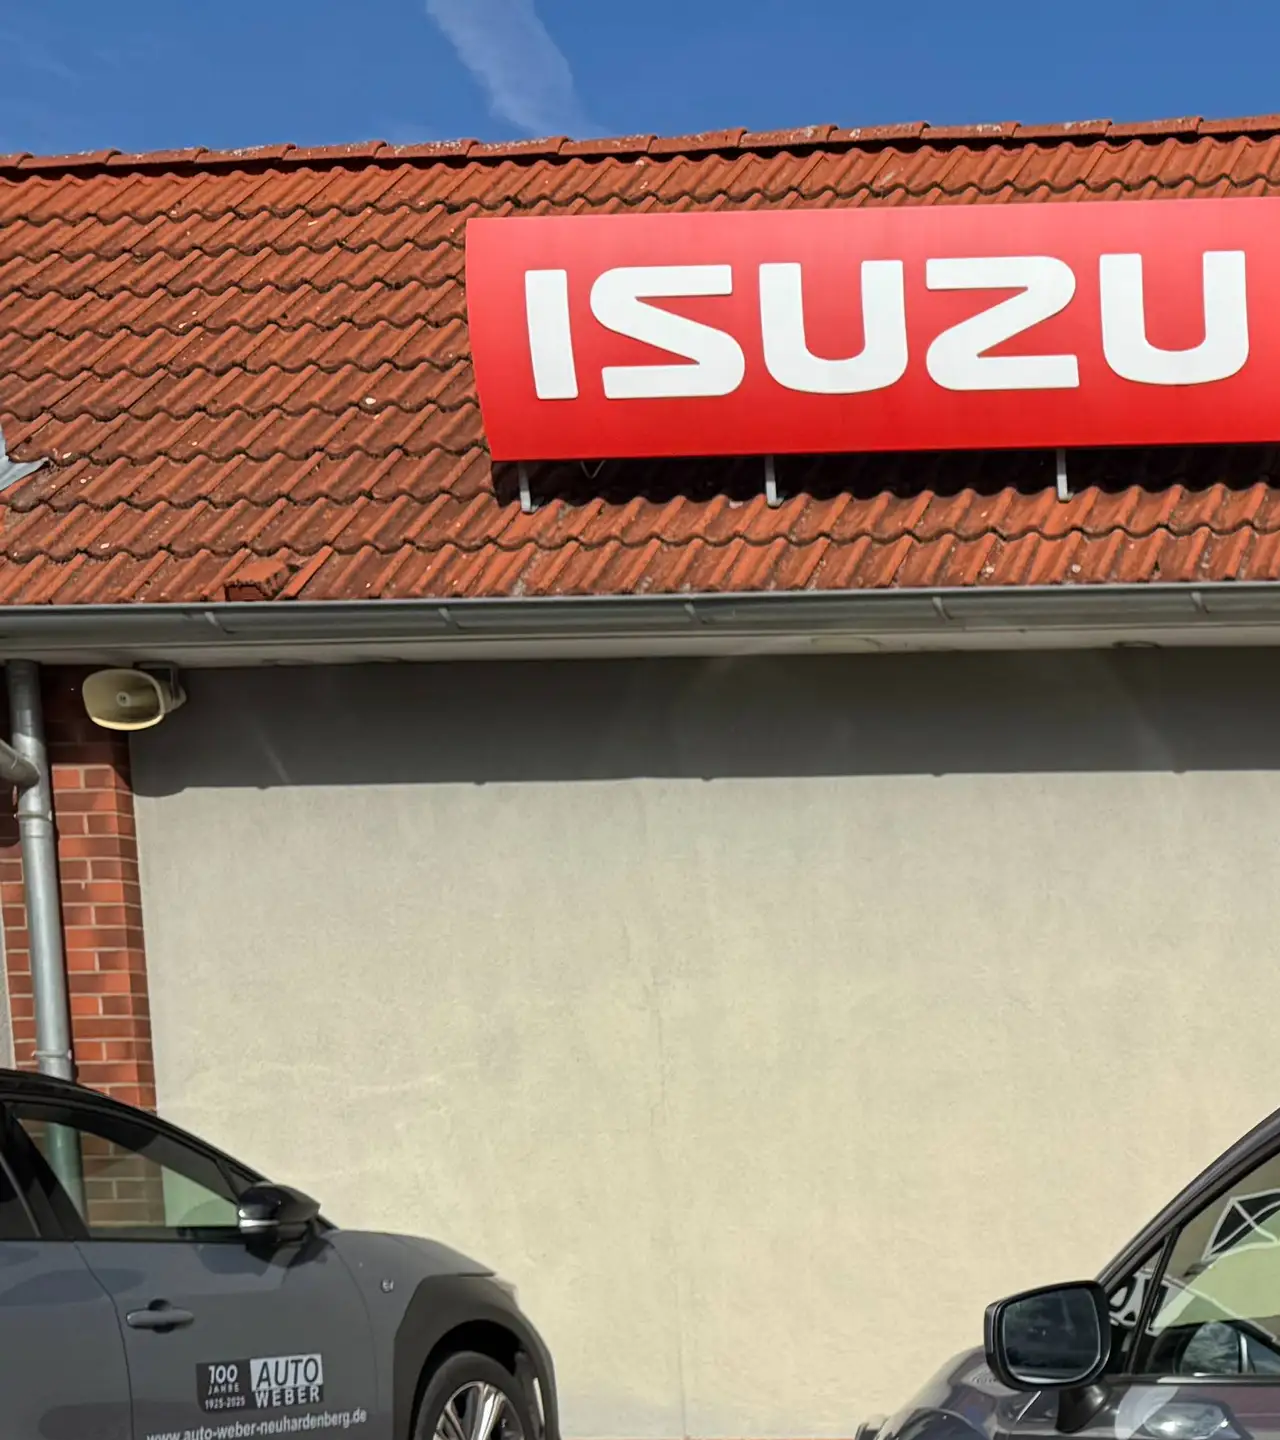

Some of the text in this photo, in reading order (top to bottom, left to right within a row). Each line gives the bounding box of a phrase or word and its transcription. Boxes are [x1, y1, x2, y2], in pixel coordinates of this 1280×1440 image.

[524, 250, 1250, 400] ISUZU
[208, 1364, 238, 1384] 100
[256, 1357, 319, 1387] AUTO
[255, 1385, 320, 1409] WEBER
